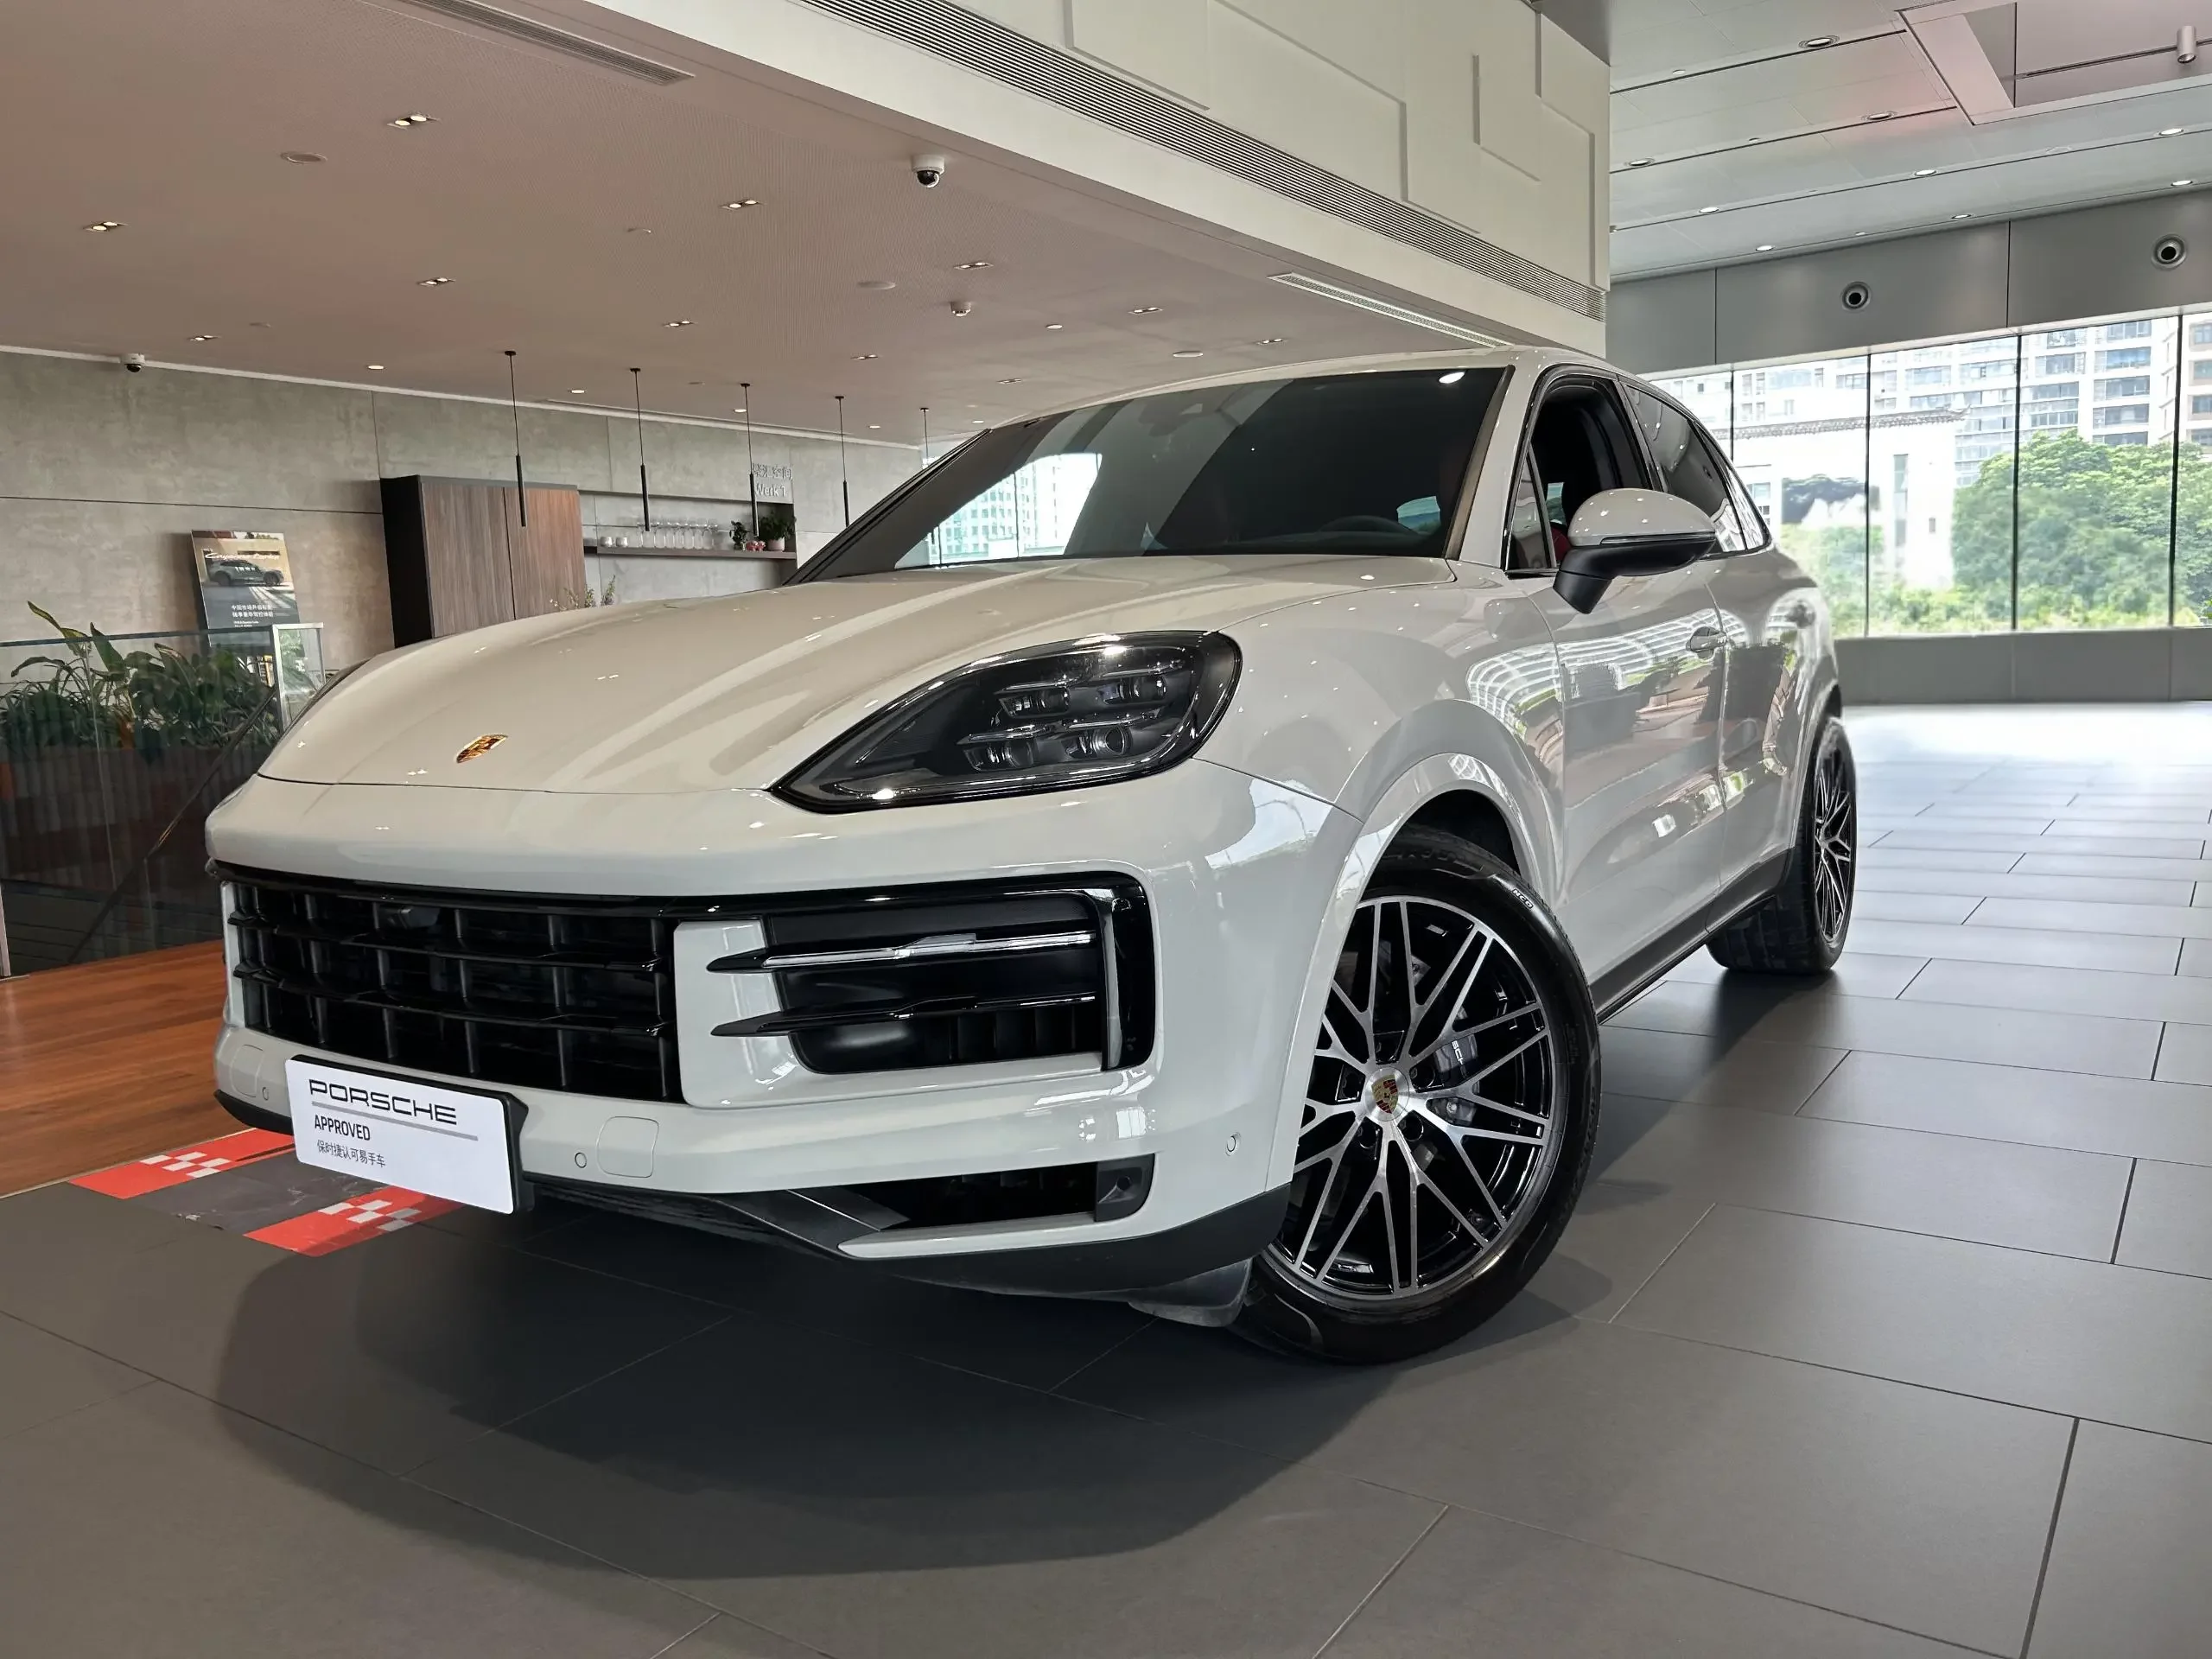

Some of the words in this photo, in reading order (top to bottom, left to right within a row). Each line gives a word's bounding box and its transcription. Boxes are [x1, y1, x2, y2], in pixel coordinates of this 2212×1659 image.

[754, 483, 779, 498] Werk
[308, 1079, 458, 1126] PORSCHE
[315, 1114, 371, 1141] APPROVED
[316, 1139, 386, 1168] 保时捷认可易手车
